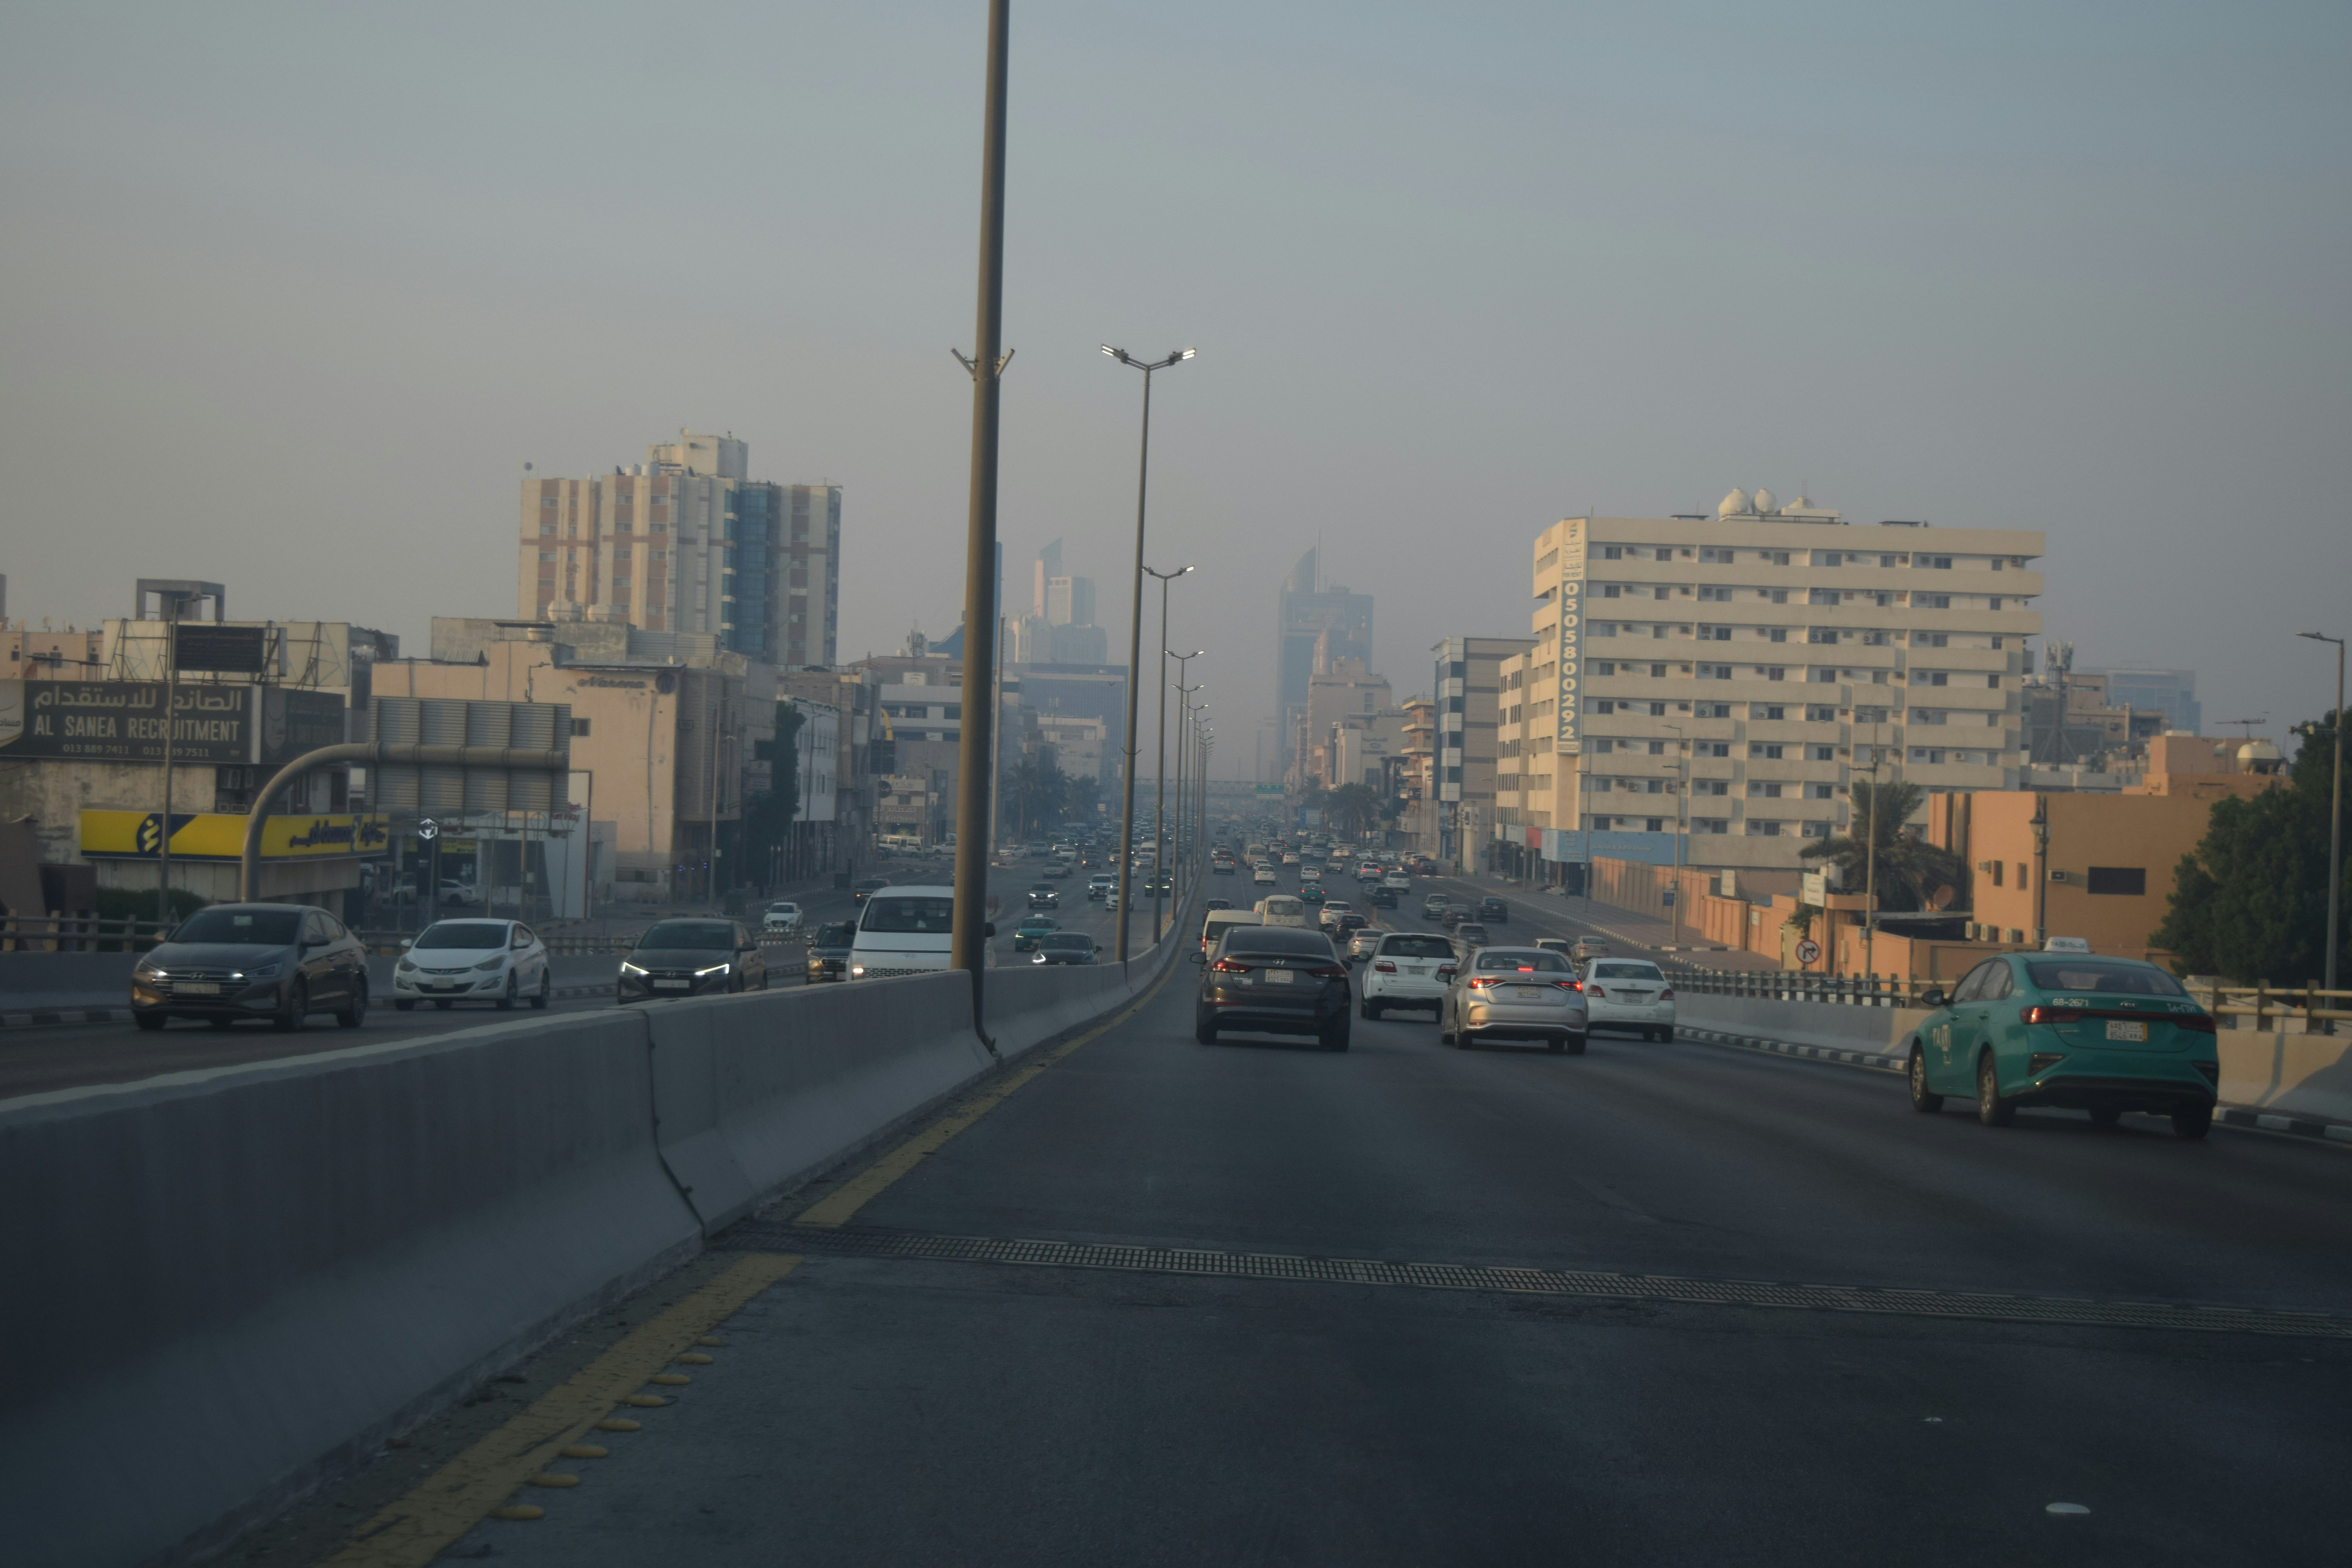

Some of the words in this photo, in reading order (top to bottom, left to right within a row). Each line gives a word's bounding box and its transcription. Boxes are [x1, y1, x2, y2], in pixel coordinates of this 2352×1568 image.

[1561, 582, 1579, 739] 0505800292
[34, 685, 157, 710] للاستقدام
[34, 715, 55, 736] AL
[65, 715, 118, 738] SANEA
[128, 717, 240, 742] RECRUITMENT
[63, 744, 82, 753] 013
[85, 745, 103, 753] 889
[105, 746, 130, 754] 7411
[143, 747, 162, 755] 013
[186, 748, 210, 757] 7511
[2053, 998, 2089, 1007] 68-2671
